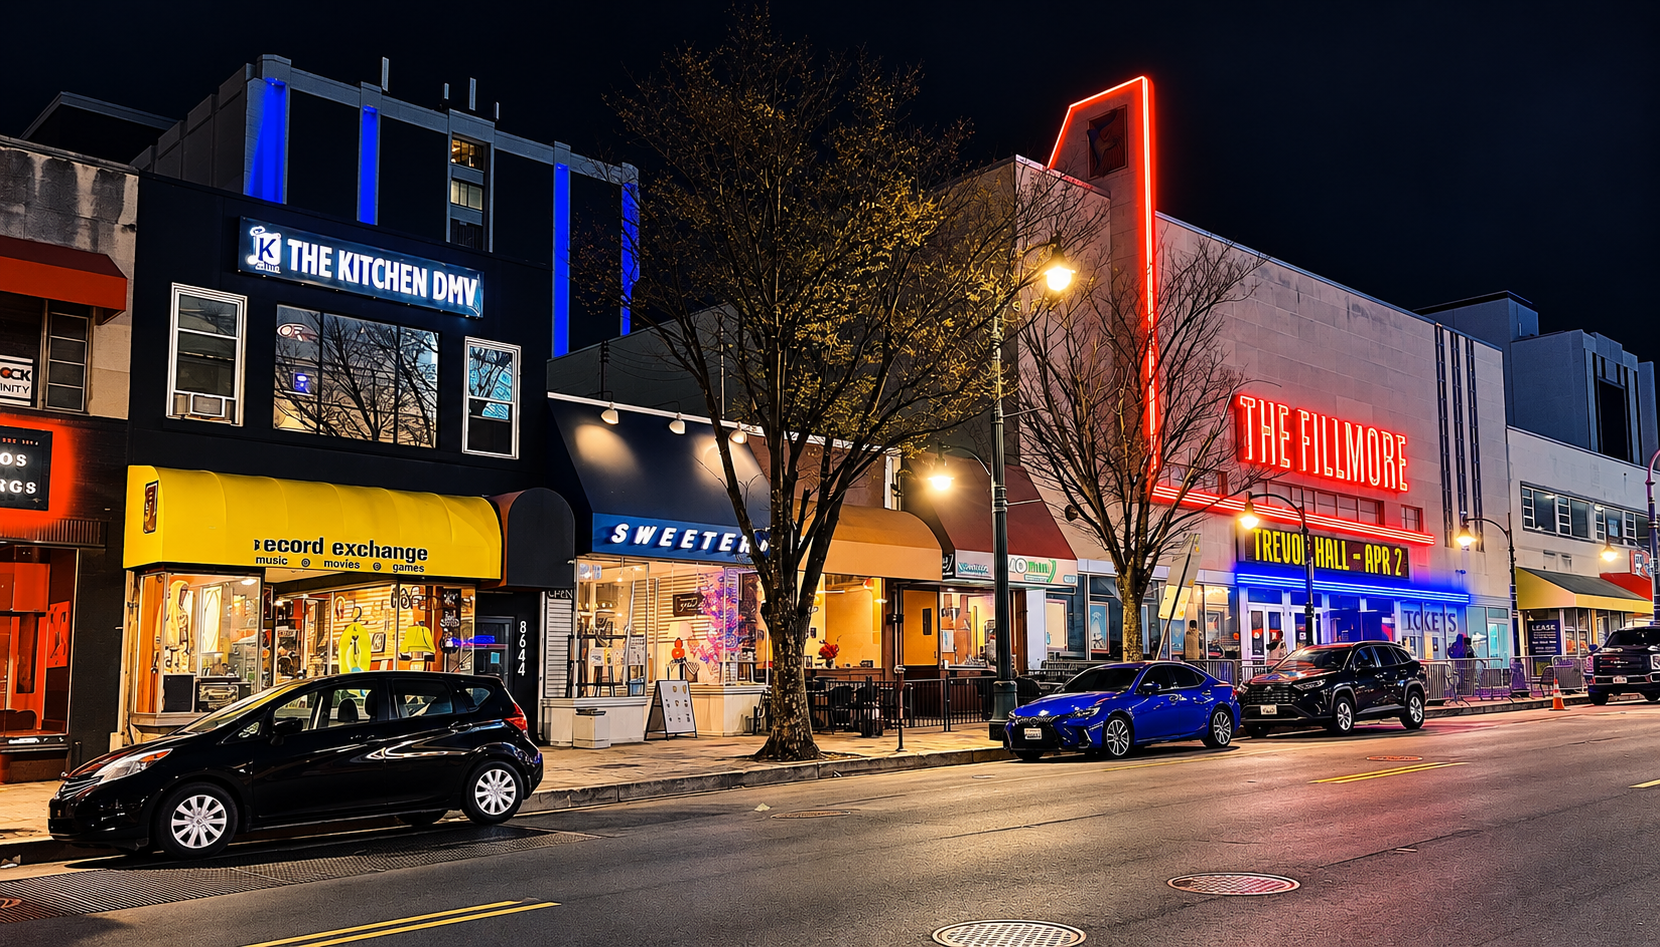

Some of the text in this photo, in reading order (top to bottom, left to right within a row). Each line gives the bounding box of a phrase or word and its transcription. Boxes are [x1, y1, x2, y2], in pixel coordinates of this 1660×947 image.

[287, 238, 478, 307] THE KITCHEN DMV
[1239, 395, 1409, 492] THE FILLMORE
[332, 539, 428, 563] exchange
[610, 523, 769, 553] SWEETER
[1314, 536, 1350, 571] HALL
[1365, 544, 1391, 576] APR
[1394, 547, 1403, 577] 2
[255, 555, 425, 574] music movies games
[517, 620, 527, 677] 8644
